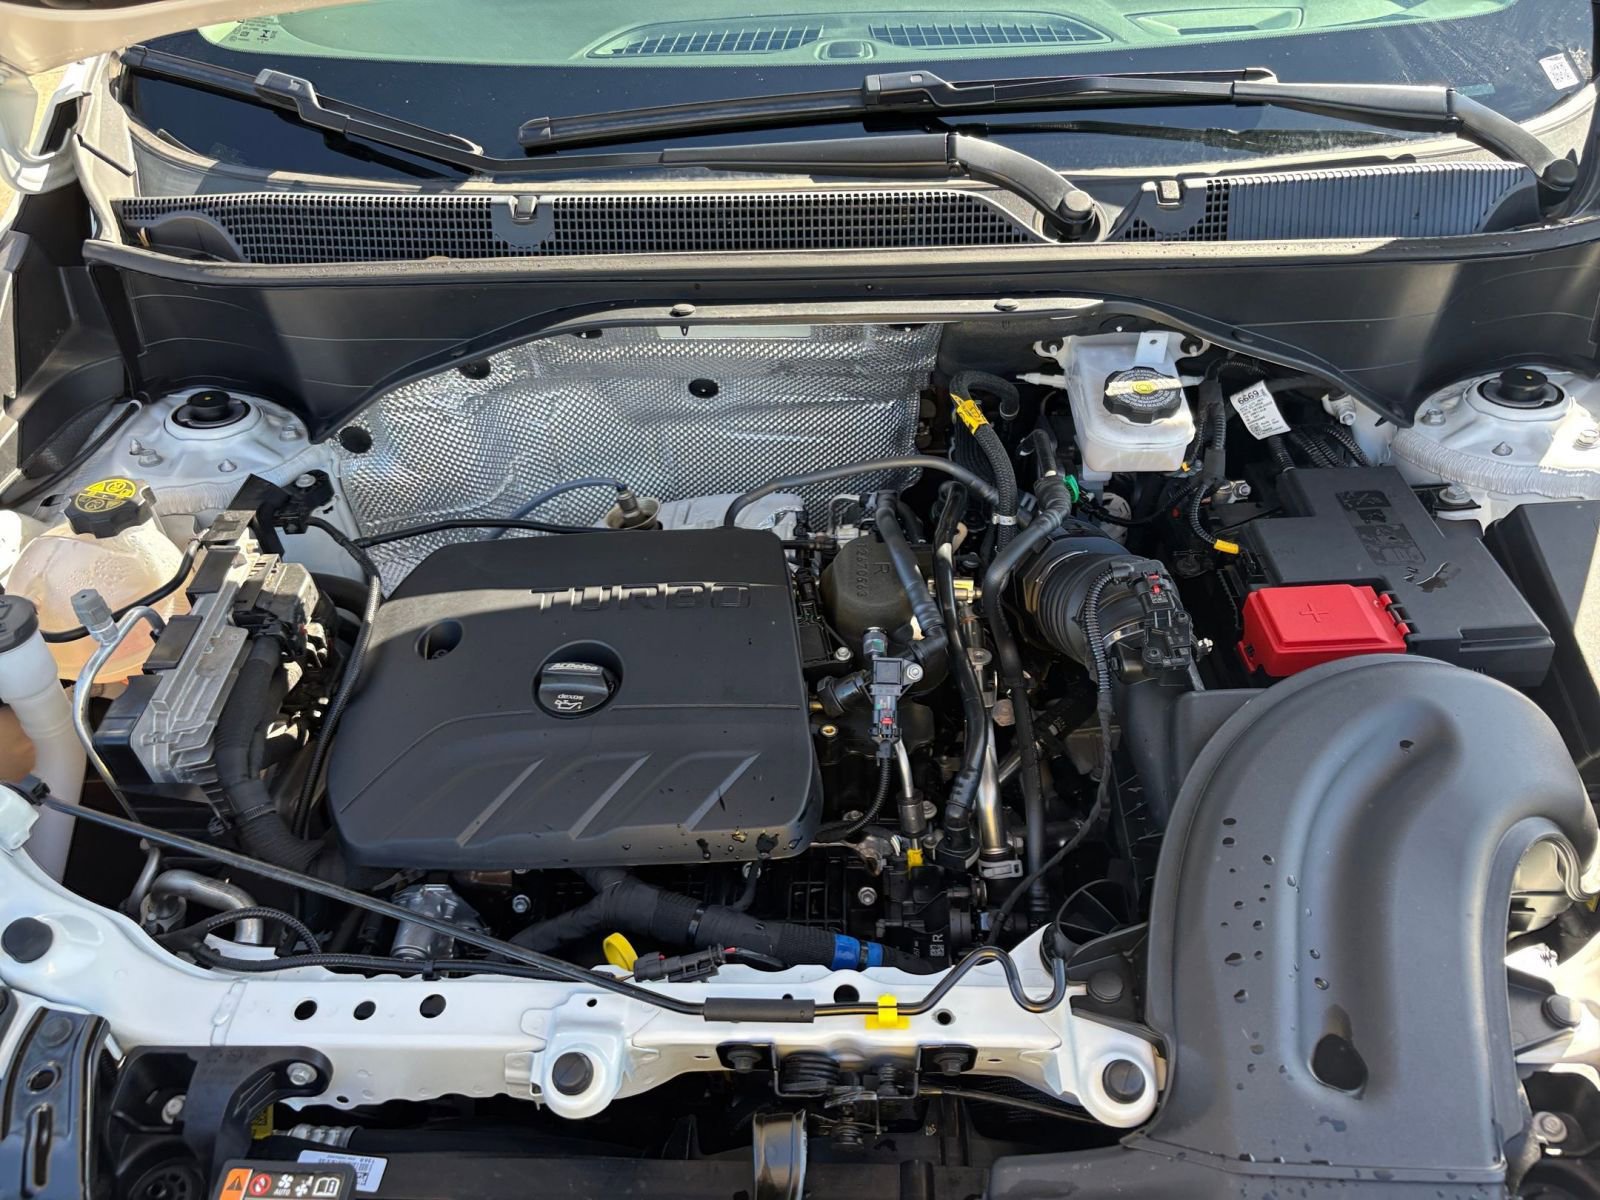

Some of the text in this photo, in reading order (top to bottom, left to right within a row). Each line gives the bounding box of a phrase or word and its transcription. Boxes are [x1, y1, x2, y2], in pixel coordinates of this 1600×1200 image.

[530, 582, 750, 610] TURBO
[548, 662, 598, 671] ACDelco
[273, 1188, 291, 1196] AUTO
